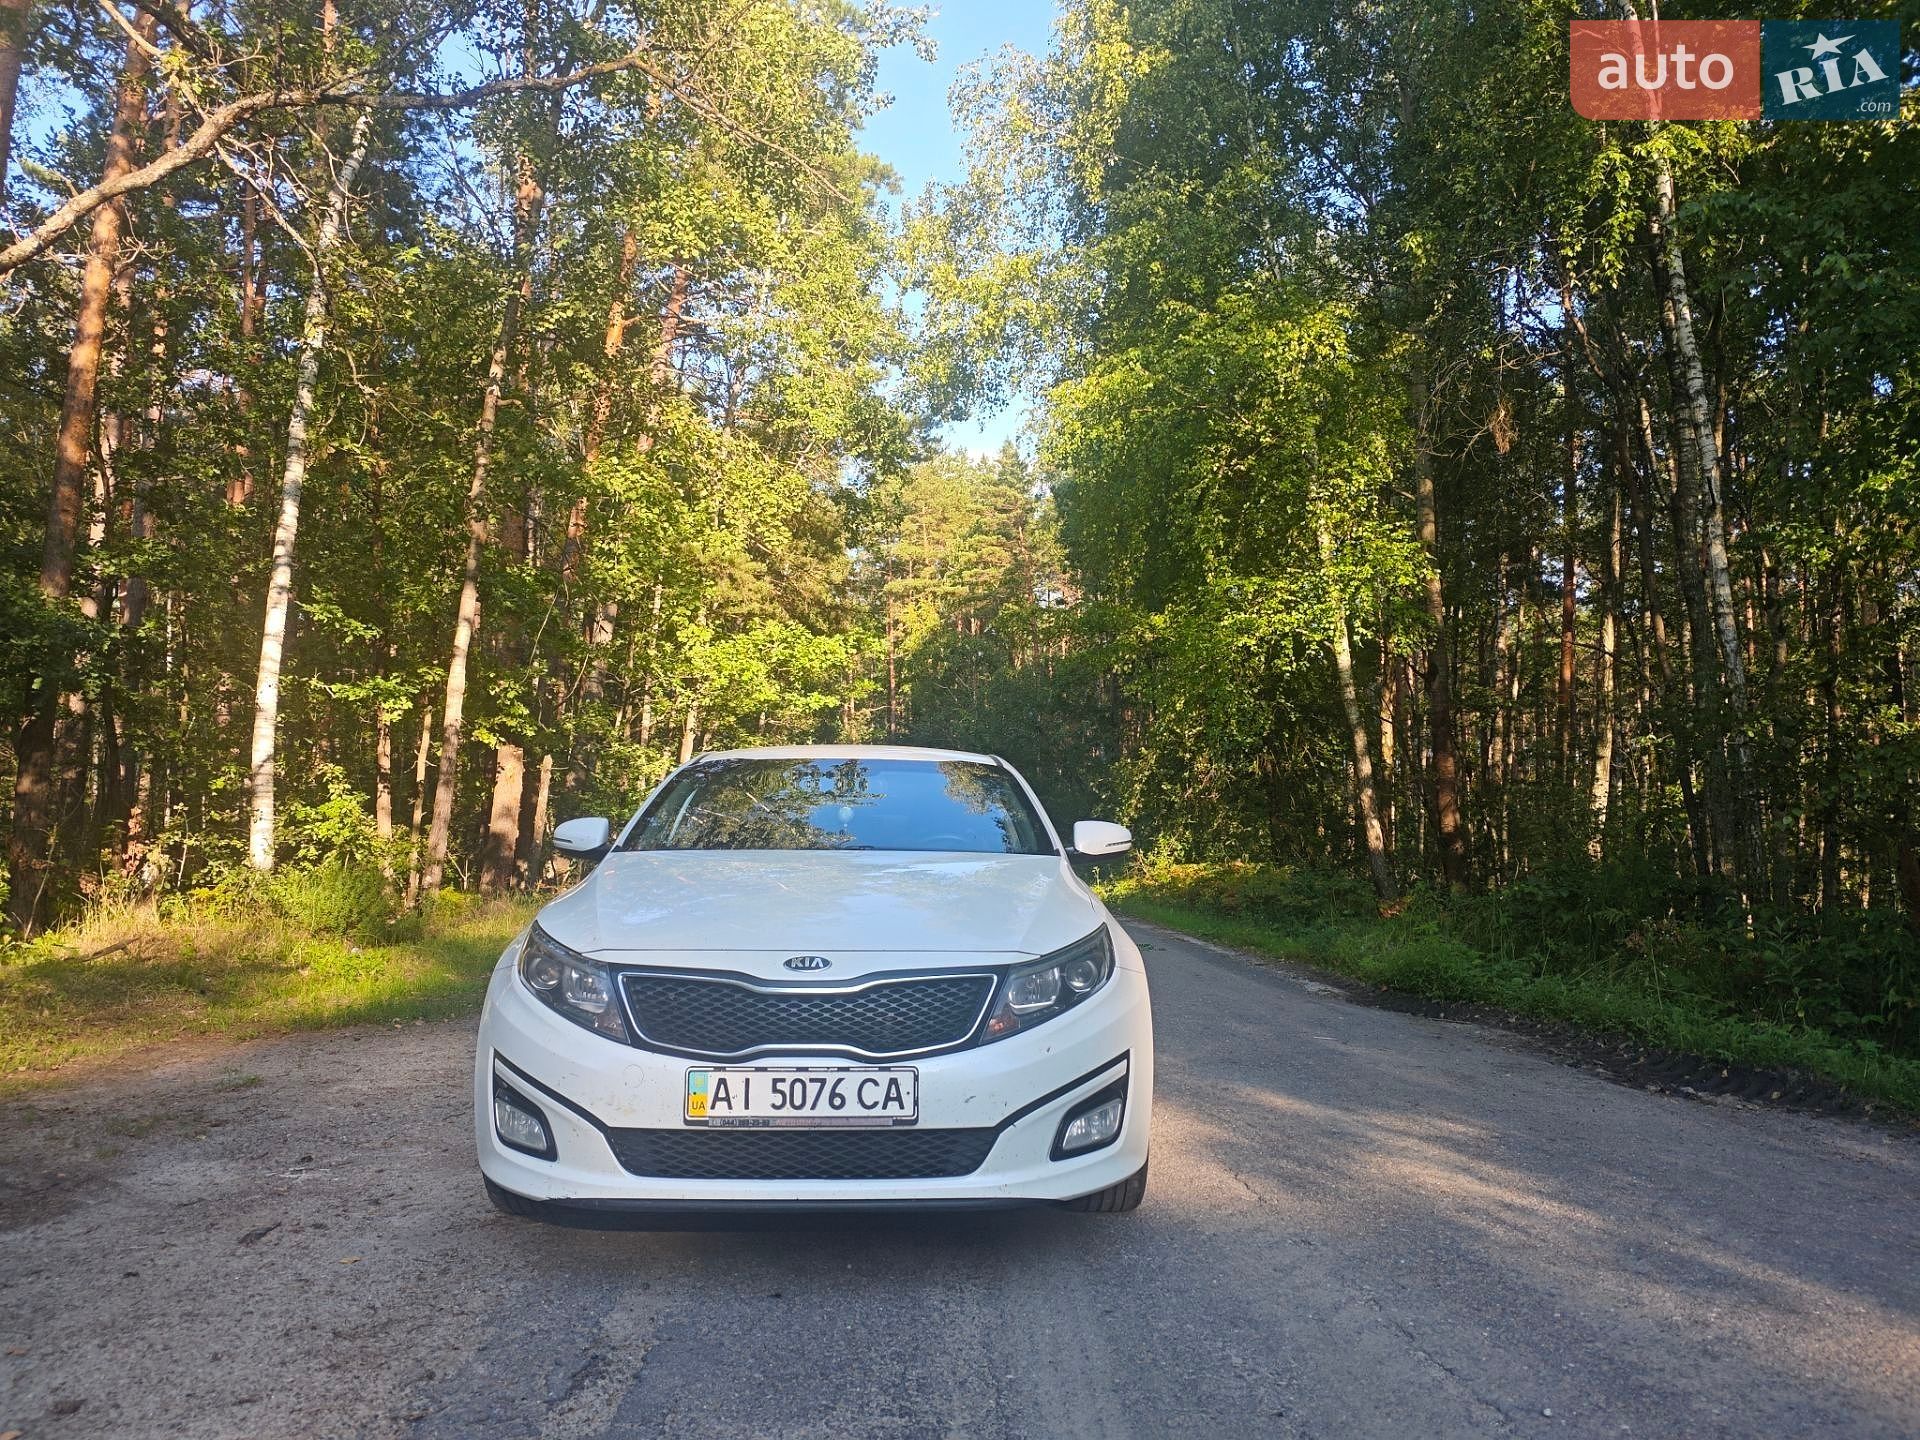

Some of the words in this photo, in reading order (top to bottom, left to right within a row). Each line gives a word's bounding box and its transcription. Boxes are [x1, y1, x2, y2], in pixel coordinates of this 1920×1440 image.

[790, 957, 824, 968] KIA
[710, 1077, 750, 1111] AI
[771, 1077, 846, 1111] 5076
[857, 1077, 905, 1111] CA
[691, 1101, 706, 1111] UA
